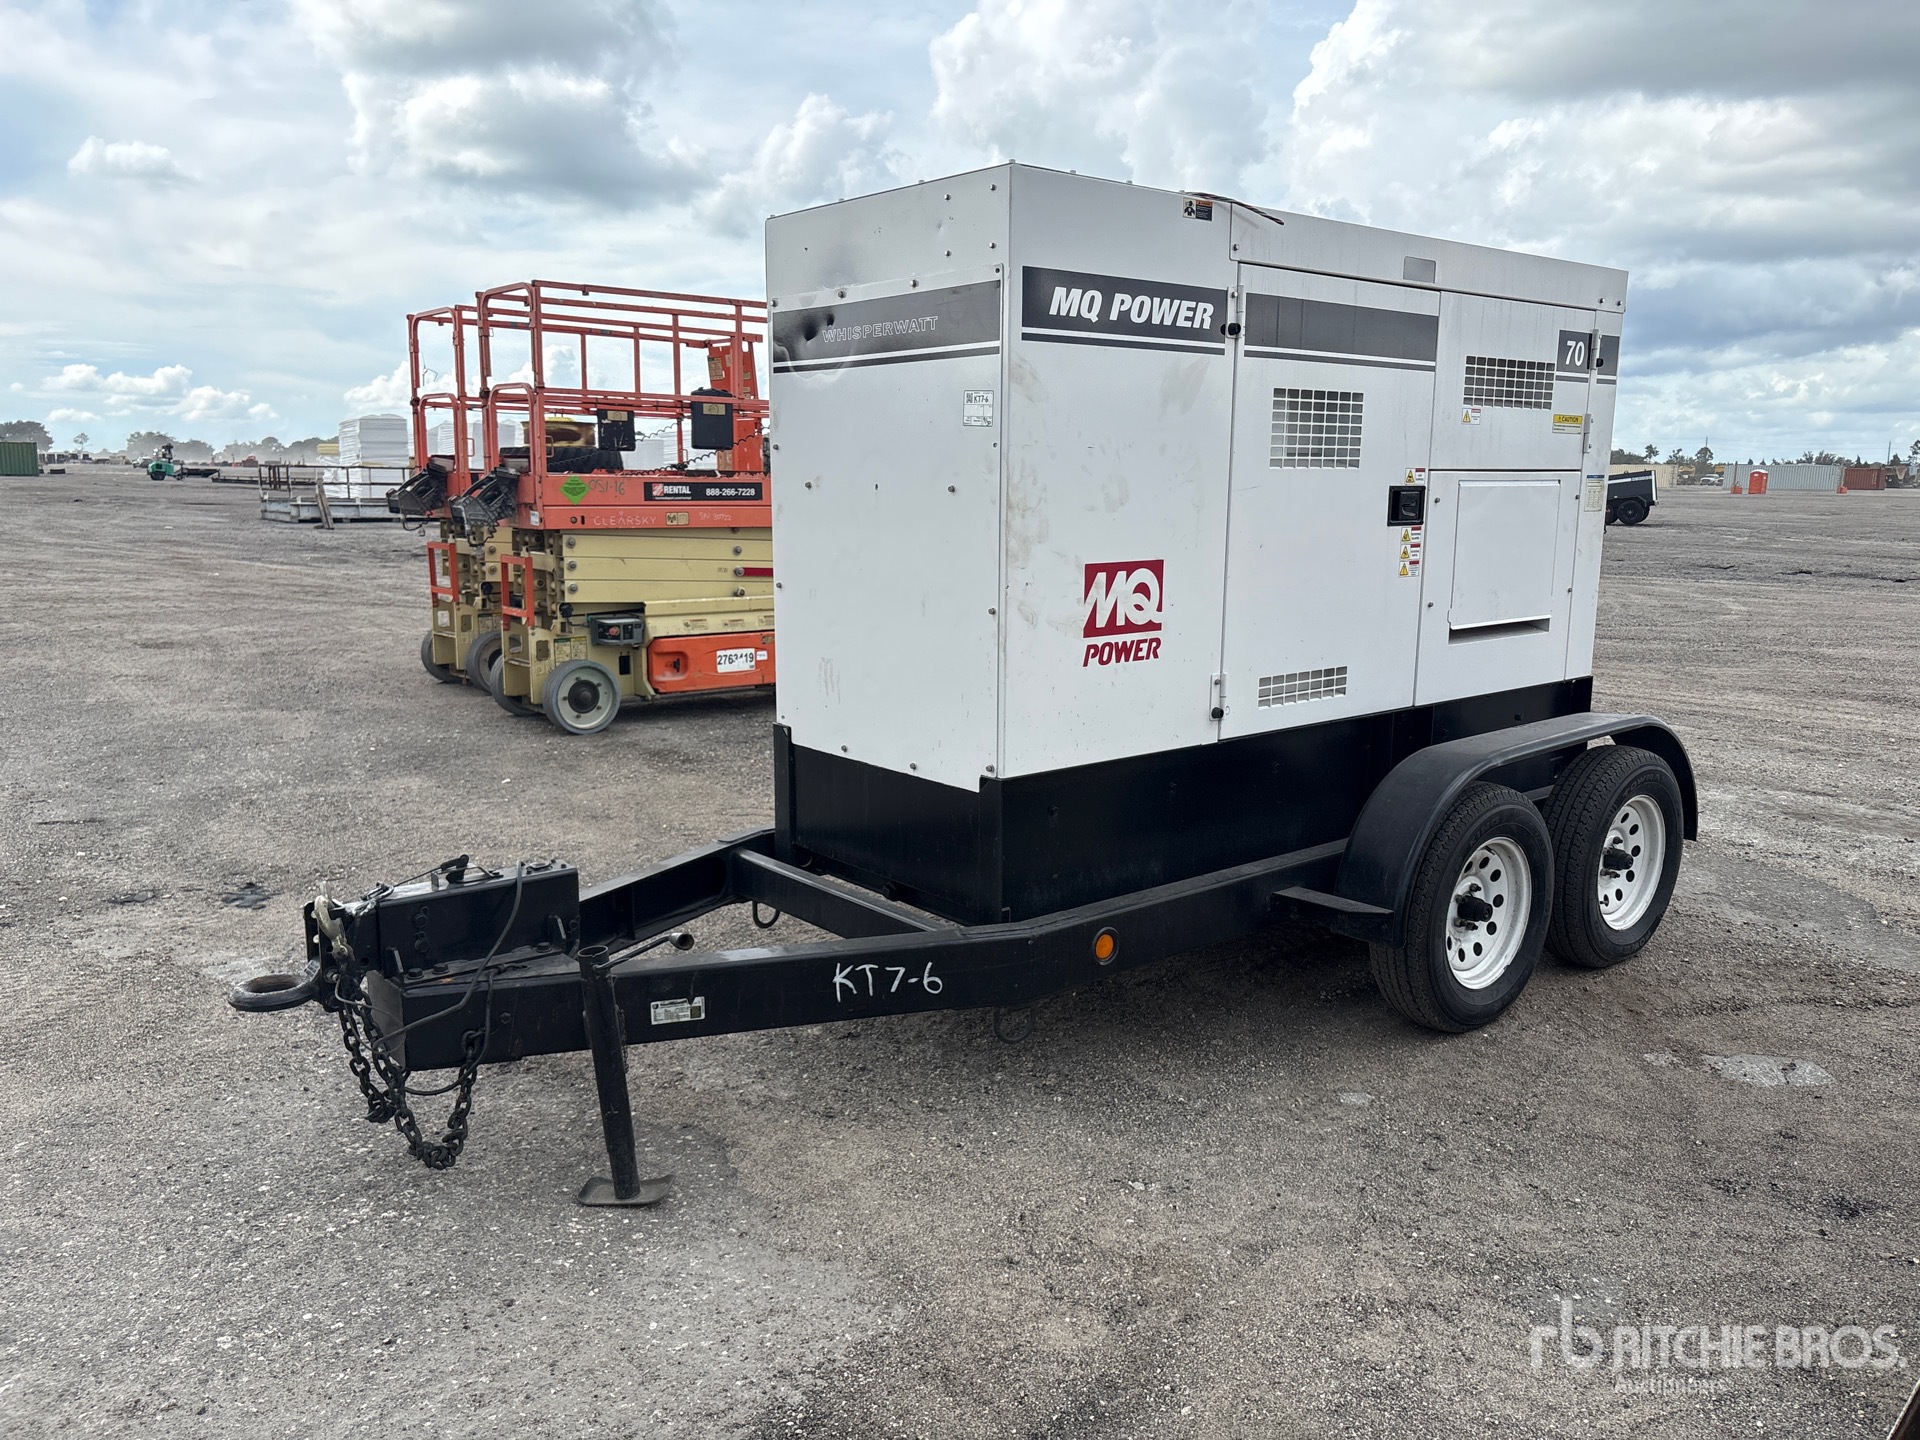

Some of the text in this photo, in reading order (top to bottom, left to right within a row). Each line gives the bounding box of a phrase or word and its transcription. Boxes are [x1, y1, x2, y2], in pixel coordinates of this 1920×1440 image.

[1048, 286, 1215, 331] MQ POWER
[822, 315, 939, 344] WHISPERWATT
[1565, 340, 1585, 367] 70
[973, 394, 989, 404] KT7-6
[663, 485, 692, 495] RENTAL
[705, 487, 756, 497] 888-266-7228
[593, 514, 657, 527] CLEARSKY
[1083, 567, 1163, 629] MQ
[1082, 637, 1162, 668] POWER
[832, 961, 943, 1003] KT7-6
